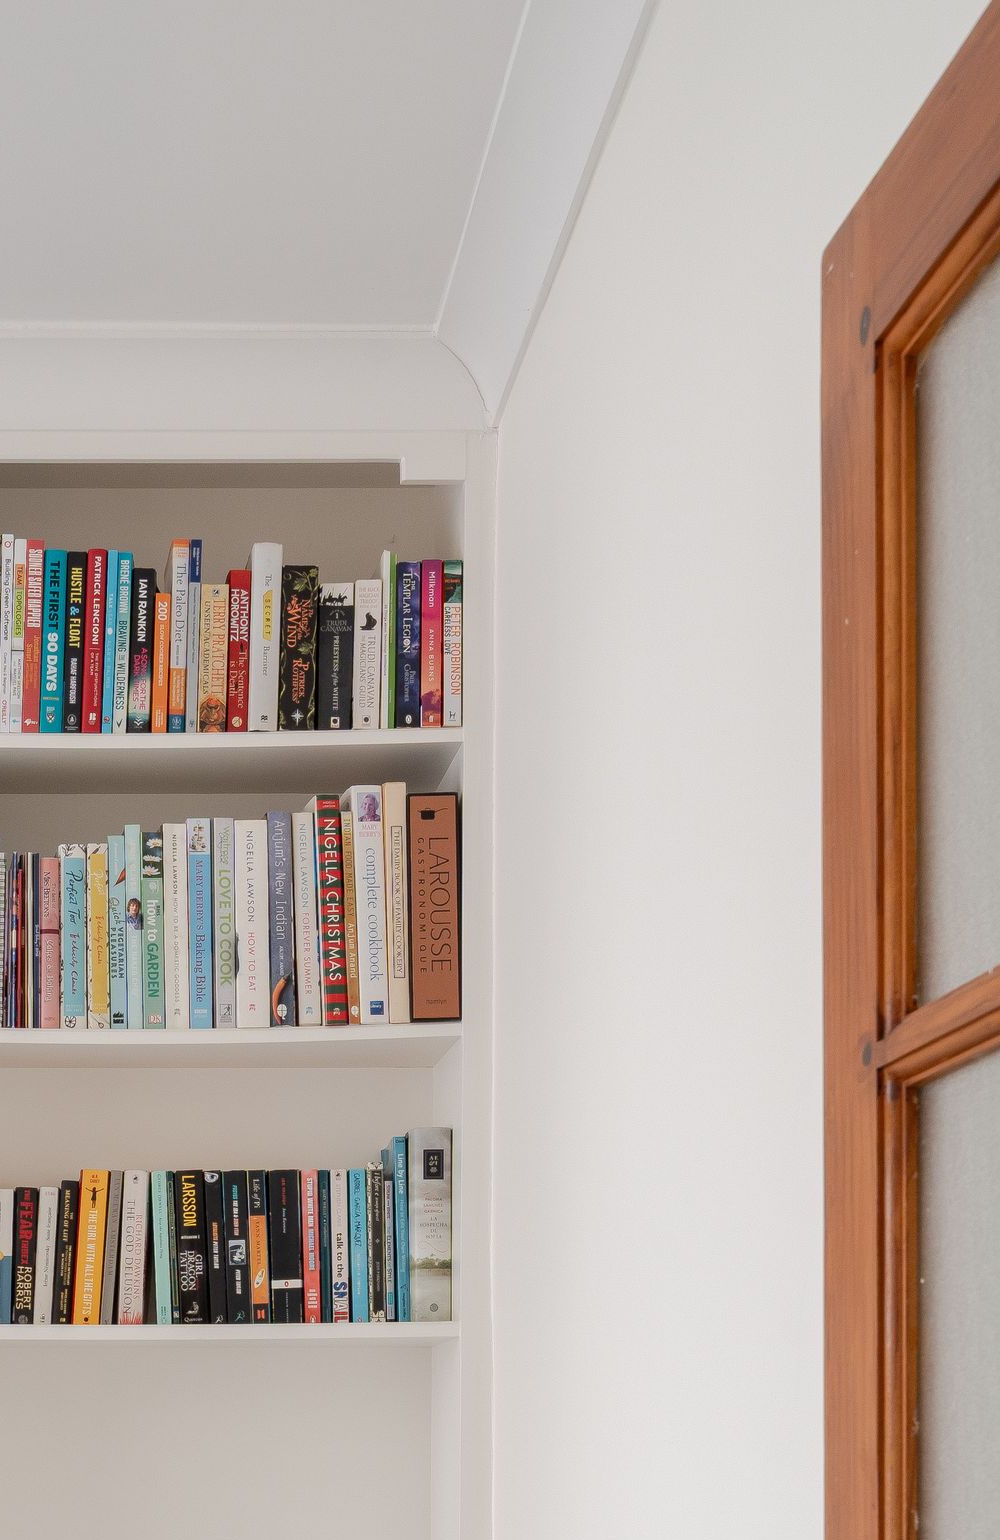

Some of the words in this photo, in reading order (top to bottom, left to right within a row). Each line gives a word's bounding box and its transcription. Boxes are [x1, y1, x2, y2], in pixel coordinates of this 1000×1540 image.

[29, 549, 42, 574] SOONER
[50, 561, 59, 587] THE
[93, 556, 101, 594] PATRICK
[176, 563, 185, 584] The
[28, 577, 42, 597] SAFER
[70, 568, 82, 603] HUSTLE
[139, 579, 148, 598] IAN
[176, 589, 185, 617] Paleo
[402, 572, 412, 614] TEMPLAR
[28, 599, 42, 627] HAPPIER
[49, 591, 59, 629] FIRST
[70, 607, 79, 615] &
[92, 598, 101, 645] LENCIONI
[137, 601, 147, 641] RANKIN
[213, 599, 226, 631] TERRY
[231, 589, 240, 642] HOROWITZ
[239, 589, 248, 641] ANTHONY
[451, 607, 460, 637] PETER
[47, 632, 58, 652] 90
[69, 618, 80, 648] FLOAT
[174, 620, 184, 642] Diet
[402, 618, 412, 653] LEGION
[46, 655, 58, 691] DAYS
[202, 637, 210, 694] ACADEMICALS
[212, 634, 225, 696] PRATCHETT
[238, 650, 247, 667] The
[451, 643, 460, 695] ROBINSON
[229, 671, 238, 696] Death
[237, 670, 245, 708] Sentence
[246, 831, 254, 873] NIGELLA
[273, 821, 286, 867] Anjum's
[299, 824, 307, 862] NIGELLA
[324, 819, 340, 885] NIGELLA
[219, 869, 231, 910] LOVE
[276, 873, 285, 895] New
[362, 848, 379, 908] complete
[147, 900, 158, 927] how
[247, 878, 255, 922] LAWSON
[395, 897, 401, 906] OF
[418, 837, 427, 972] GASTRONOMIQUE
[429, 837, 452, 972] LAROUSSE
[147, 929, 157, 941] to
[219, 913, 231, 933] TO
[276, 901, 286, 939] Indian
[302, 913, 311, 953] FOREVER
[327, 892, 341, 980] CHRISTMAS
[220, 939, 232, 985] COOK
[368, 914, 383, 981] cookbook
[147, 944, 160, 997] GARDEN
[248, 960, 255, 973] TO
[304, 957, 312, 994] SUMMER
[397, 1154, 405, 1168] Line
[397, 1170, 404, 1178] by
[89, 1210, 98, 1223] THE
[127, 1200, 135, 1222] THE
[182, 1176, 196, 1226] LARSSON
[88, 1224, 97, 1240] GIRL
[126, 1226, 134, 1252] GOD
[85, 1264, 94, 1277] ALL
[86, 1244, 96, 1262] WITH
[180, 1250, 188, 1291] TATTOO
[188, 1251, 196, 1290] DRAGON
[195, 1255, 203, 1278] GIRL
[24, 1267, 32, 1310] ROBERT
[84, 1278, 94, 1292] THE
[124, 1258, 133, 1313] DELUSION
[83, 1294, 93, 1314] GIFTS
